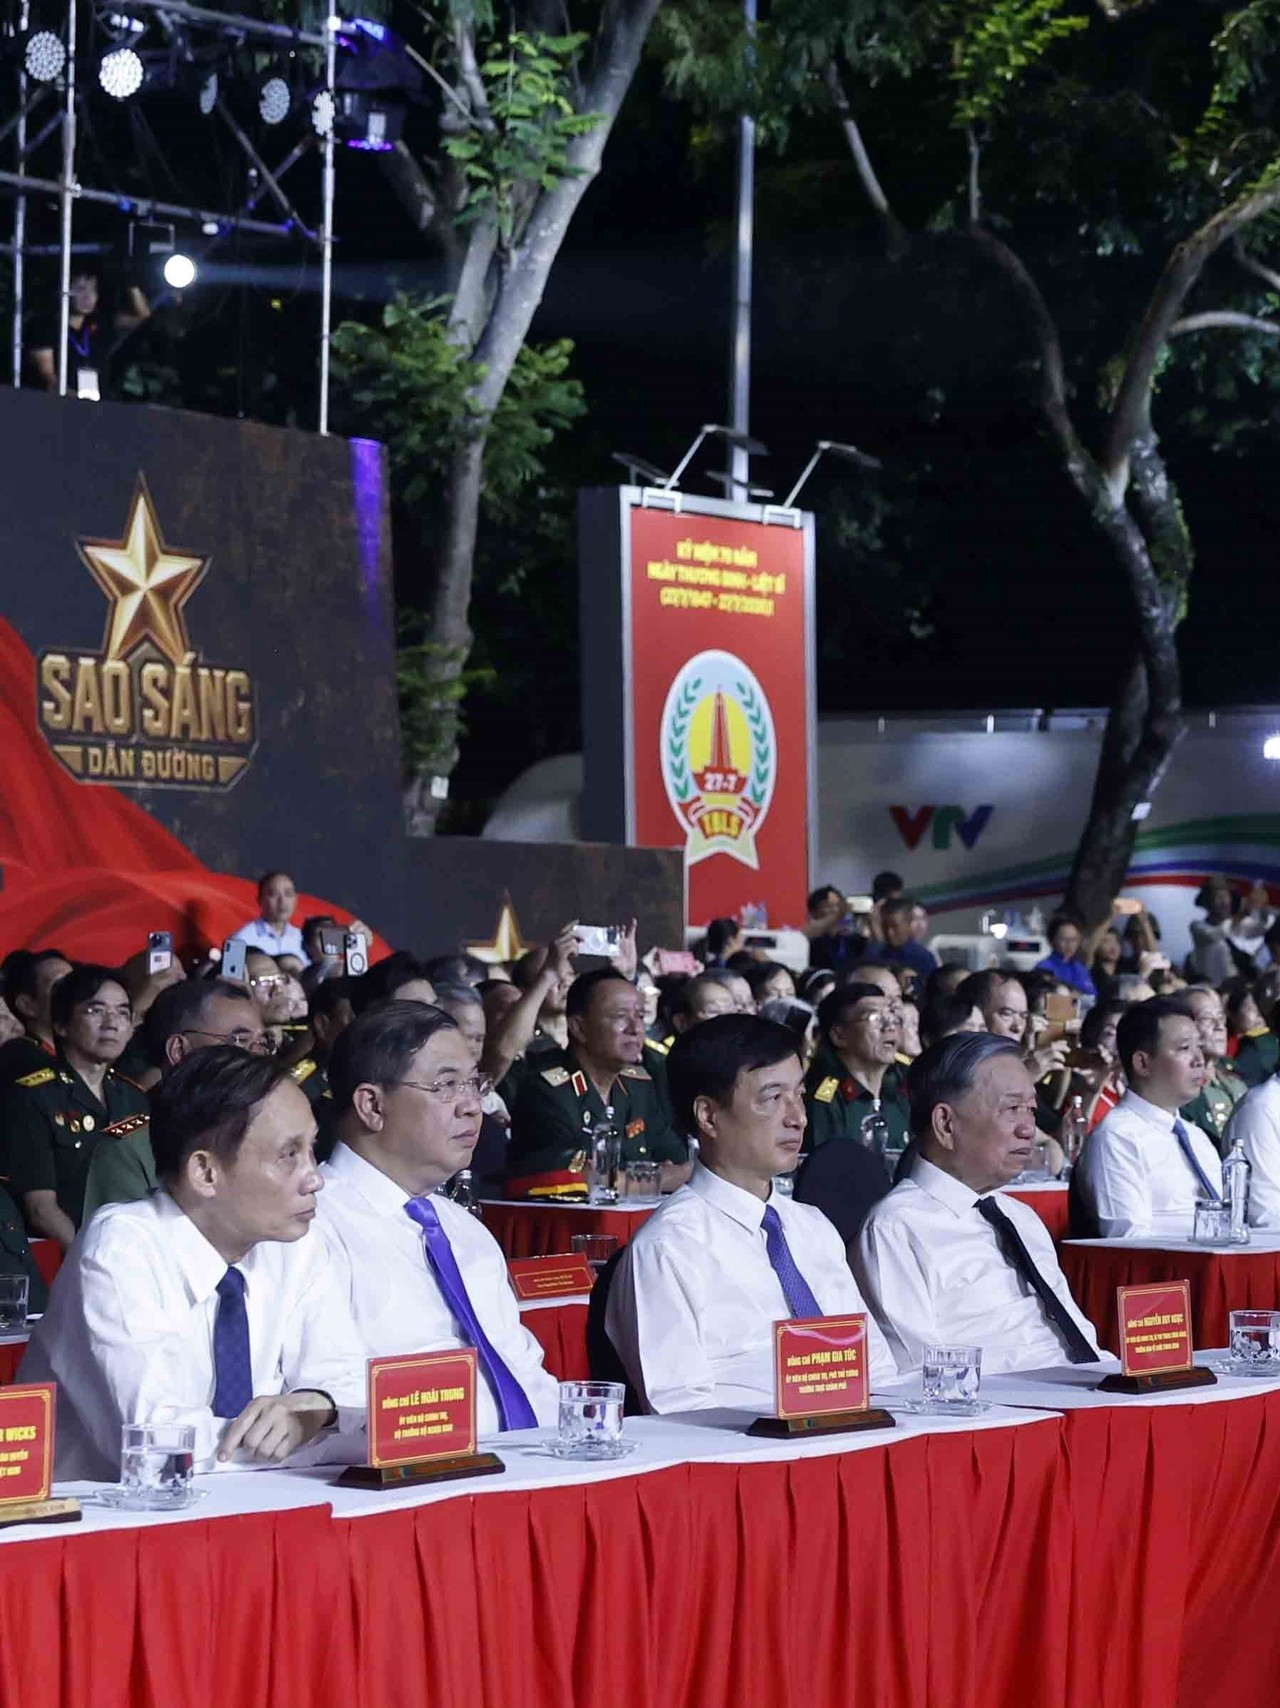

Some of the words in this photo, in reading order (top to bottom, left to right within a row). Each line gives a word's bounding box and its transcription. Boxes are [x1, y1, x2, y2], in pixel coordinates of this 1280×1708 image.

[41, 654, 131, 735] SAO
[141, 651, 251, 744] SÁNG
[142, 748, 216, 781] ĐƯỜNG
[888, 804, 994, 852] VTV
[811, 1351, 831, 1366] PHẠM
